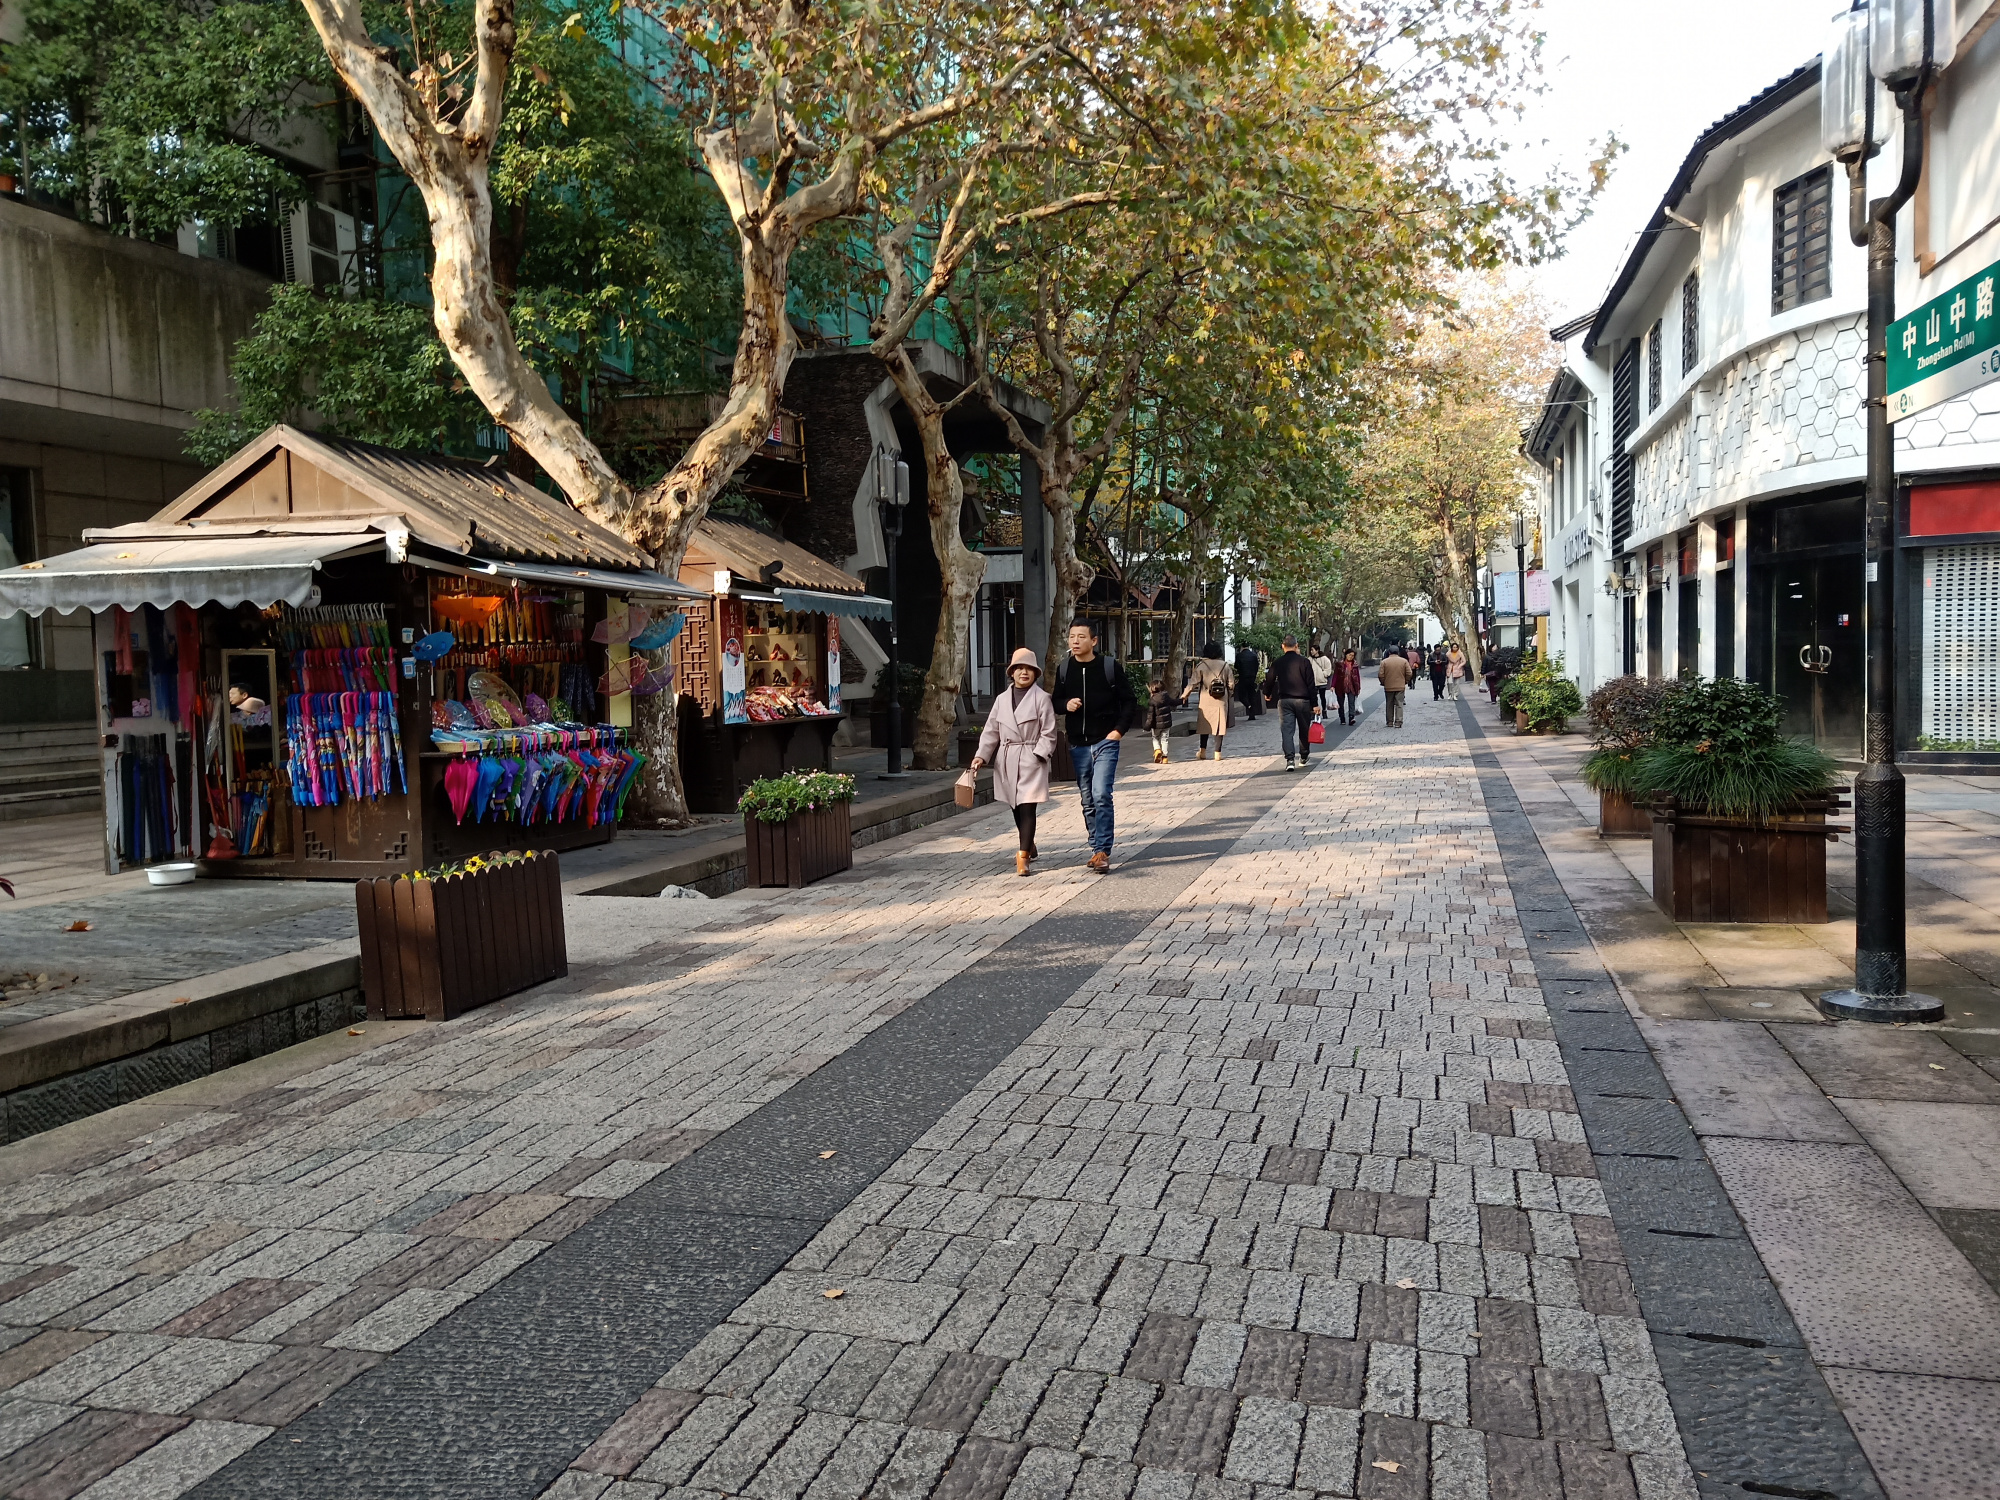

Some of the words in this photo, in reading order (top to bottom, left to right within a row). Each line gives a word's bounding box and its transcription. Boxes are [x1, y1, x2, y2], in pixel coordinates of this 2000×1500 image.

[1902, 276, 1995, 359] 中山中路
[1917, 344, 1953, 370] Zhongshan
